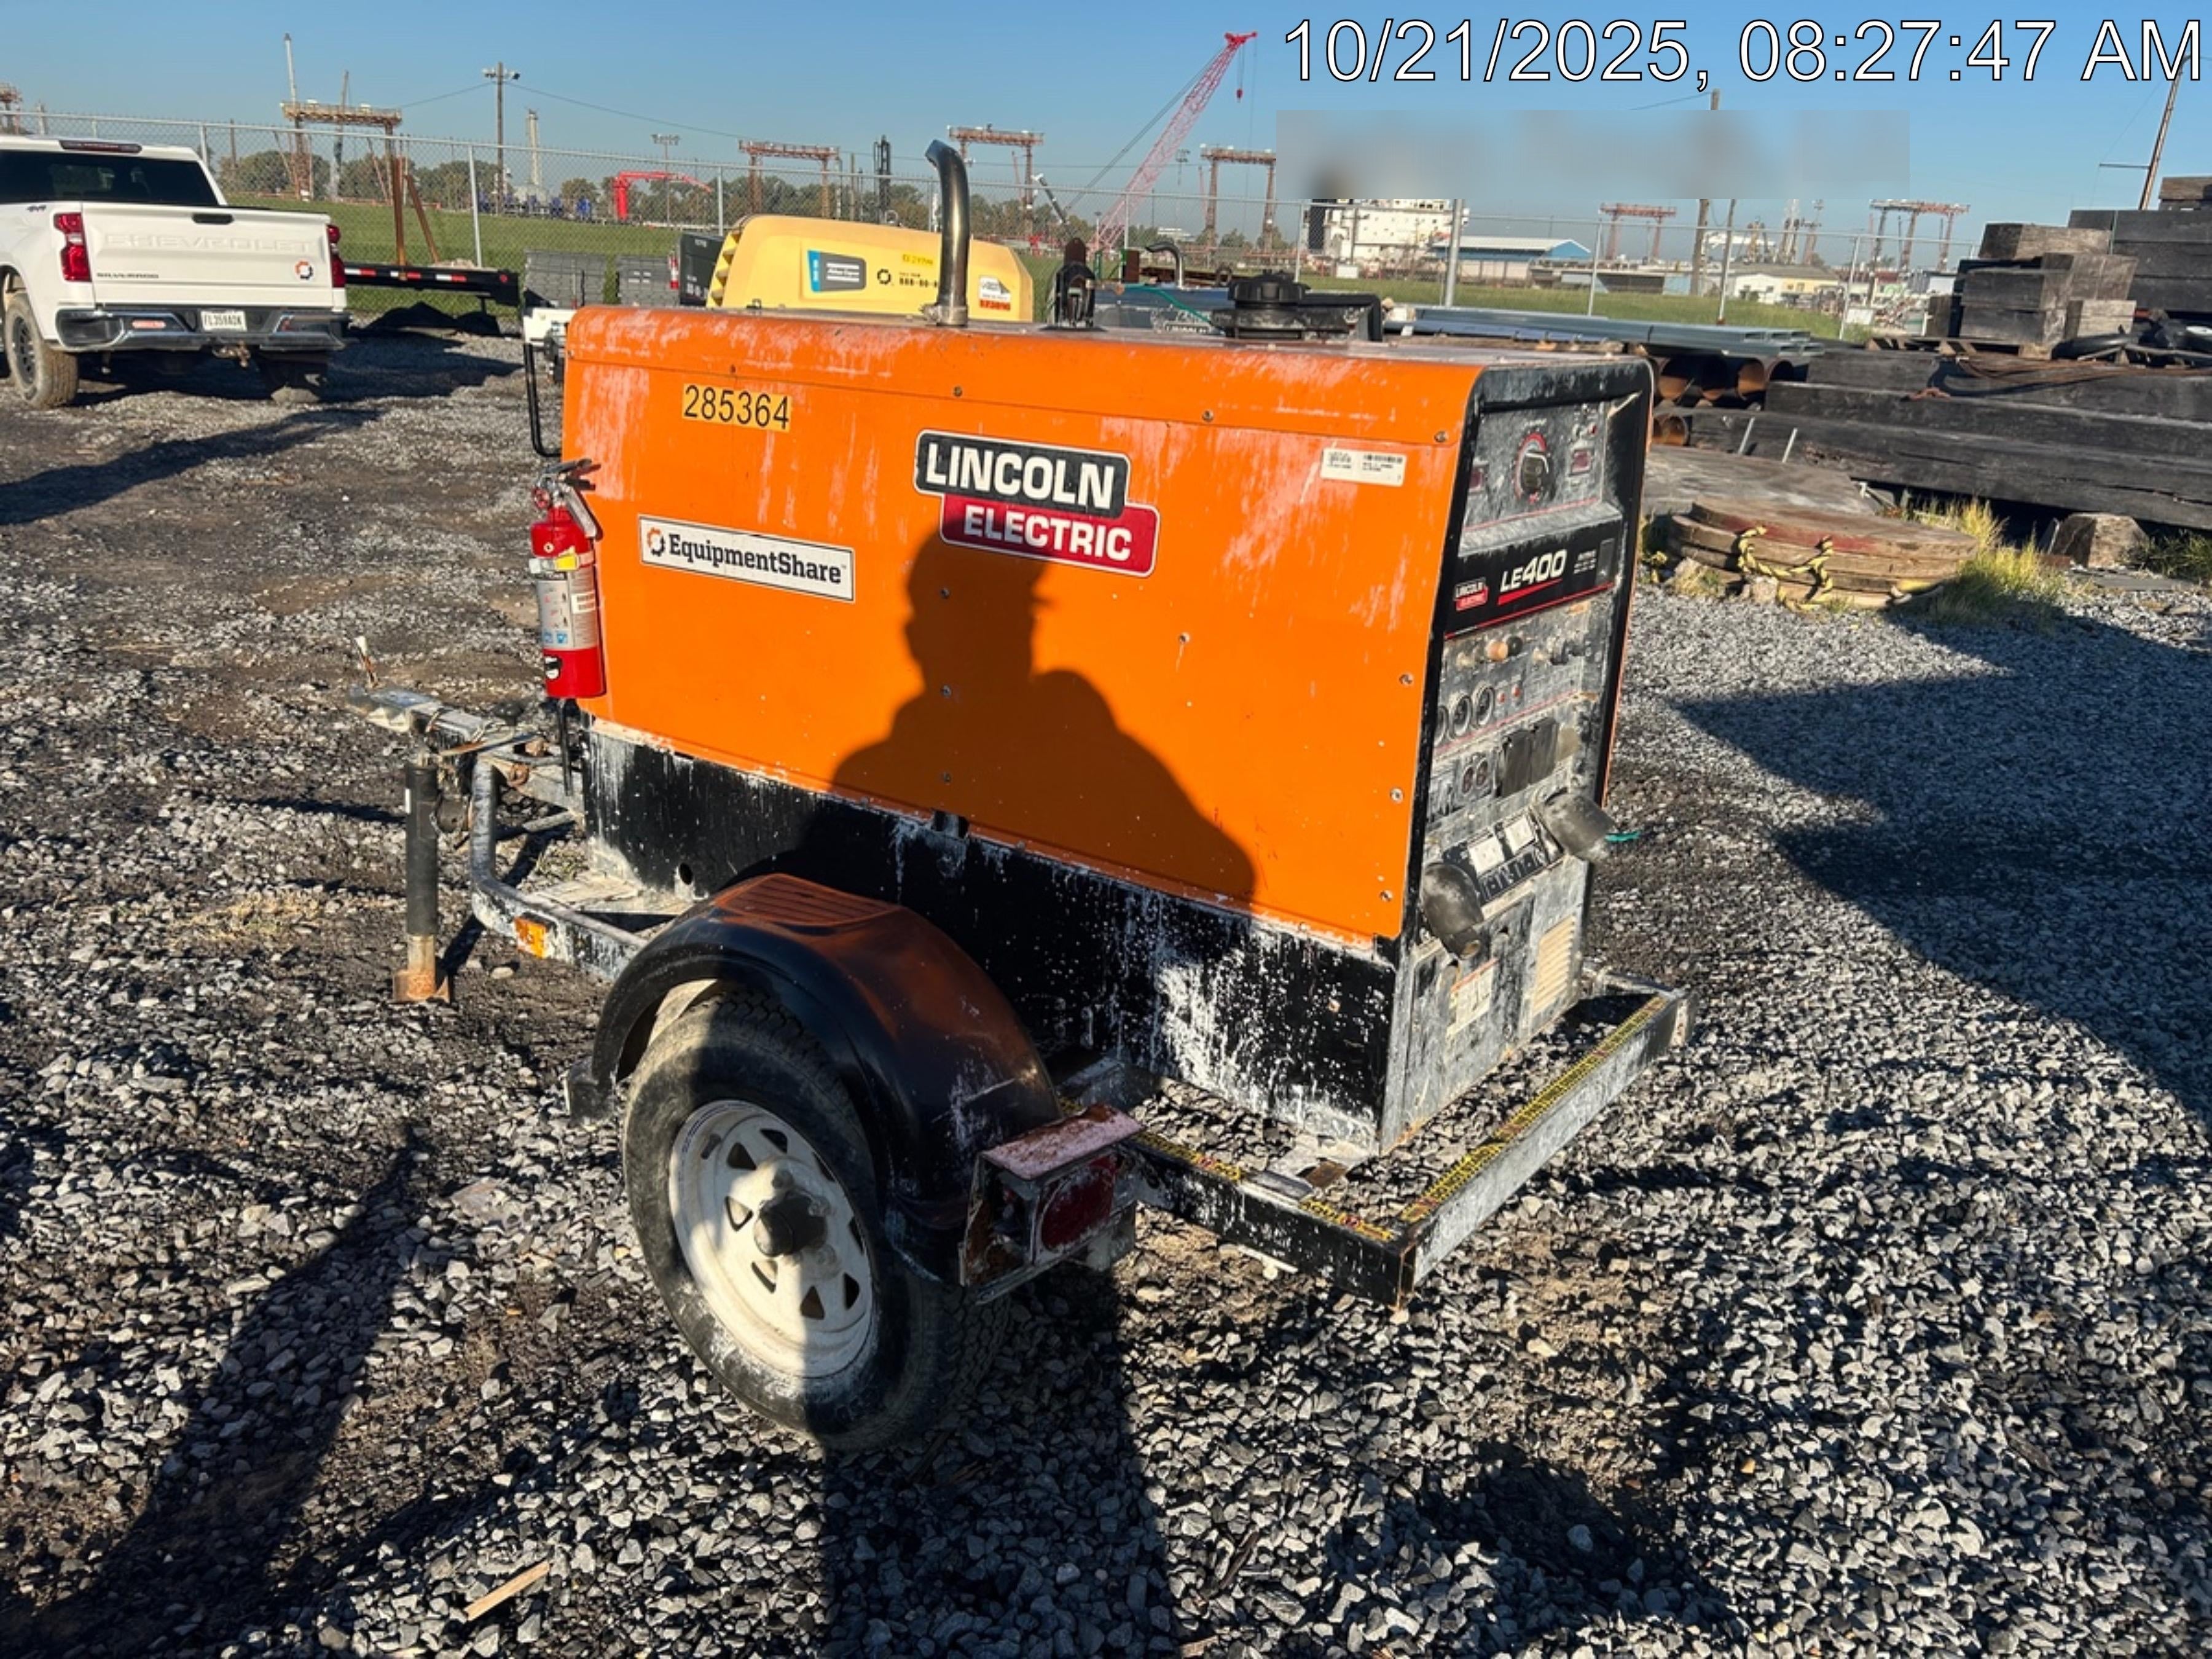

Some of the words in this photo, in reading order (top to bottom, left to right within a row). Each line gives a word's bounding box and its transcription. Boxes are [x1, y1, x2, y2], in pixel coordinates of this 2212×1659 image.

[684, 385, 789, 429] 285364
[926, 442, 1115, 509] LINCOLN
[964, 504, 1132, 561] ELECTRIC
[669, 533, 841, 584] EquipmentShare
[1500, 549, 1567, 592] LE400
